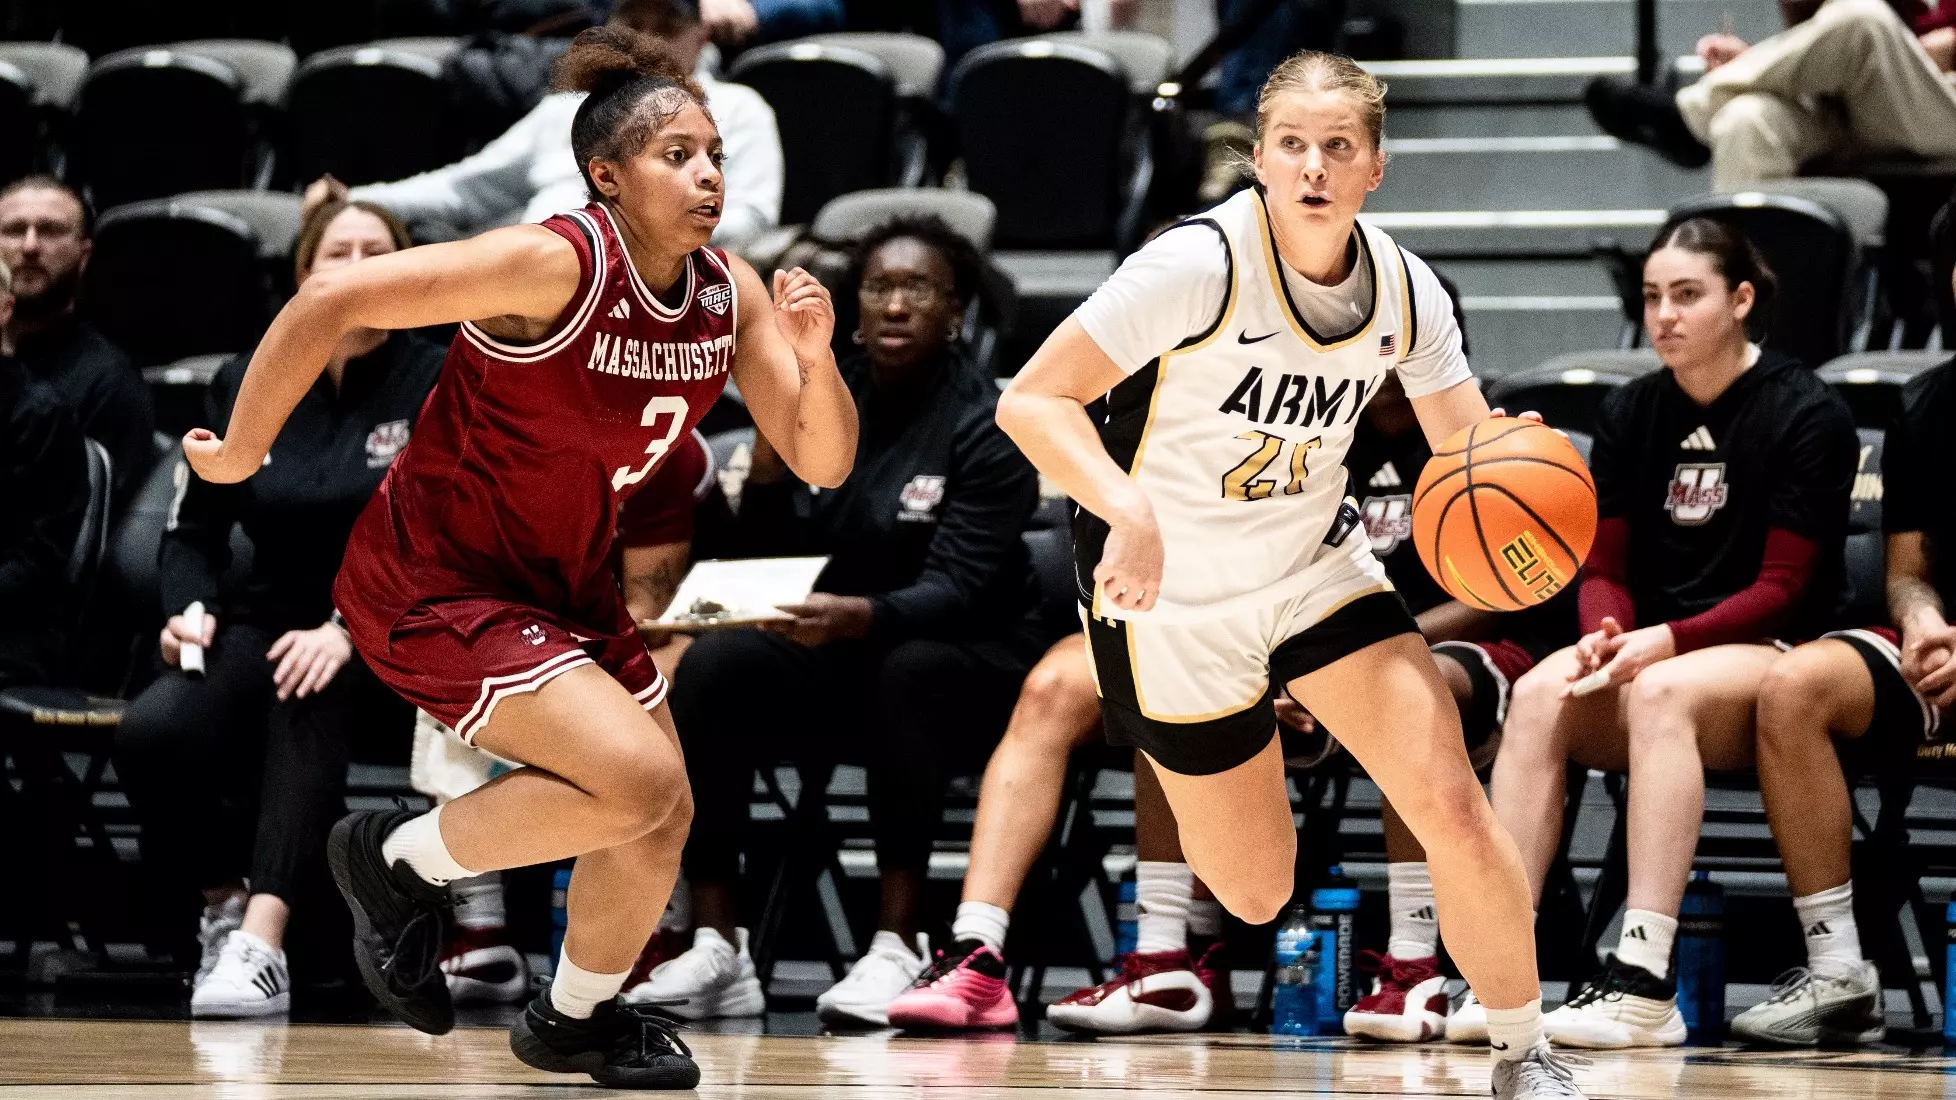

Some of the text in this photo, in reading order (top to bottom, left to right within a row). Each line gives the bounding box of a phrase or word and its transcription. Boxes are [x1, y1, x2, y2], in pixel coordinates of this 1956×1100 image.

[700, 289, 732, 308] MAC
[1218, 366, 1379, 428] ARMY
[611, 396, 690, 492] 3
[1499, 534, 1562, 601] ELITE
[1337, 913, 1353, 1008] POWERADE
